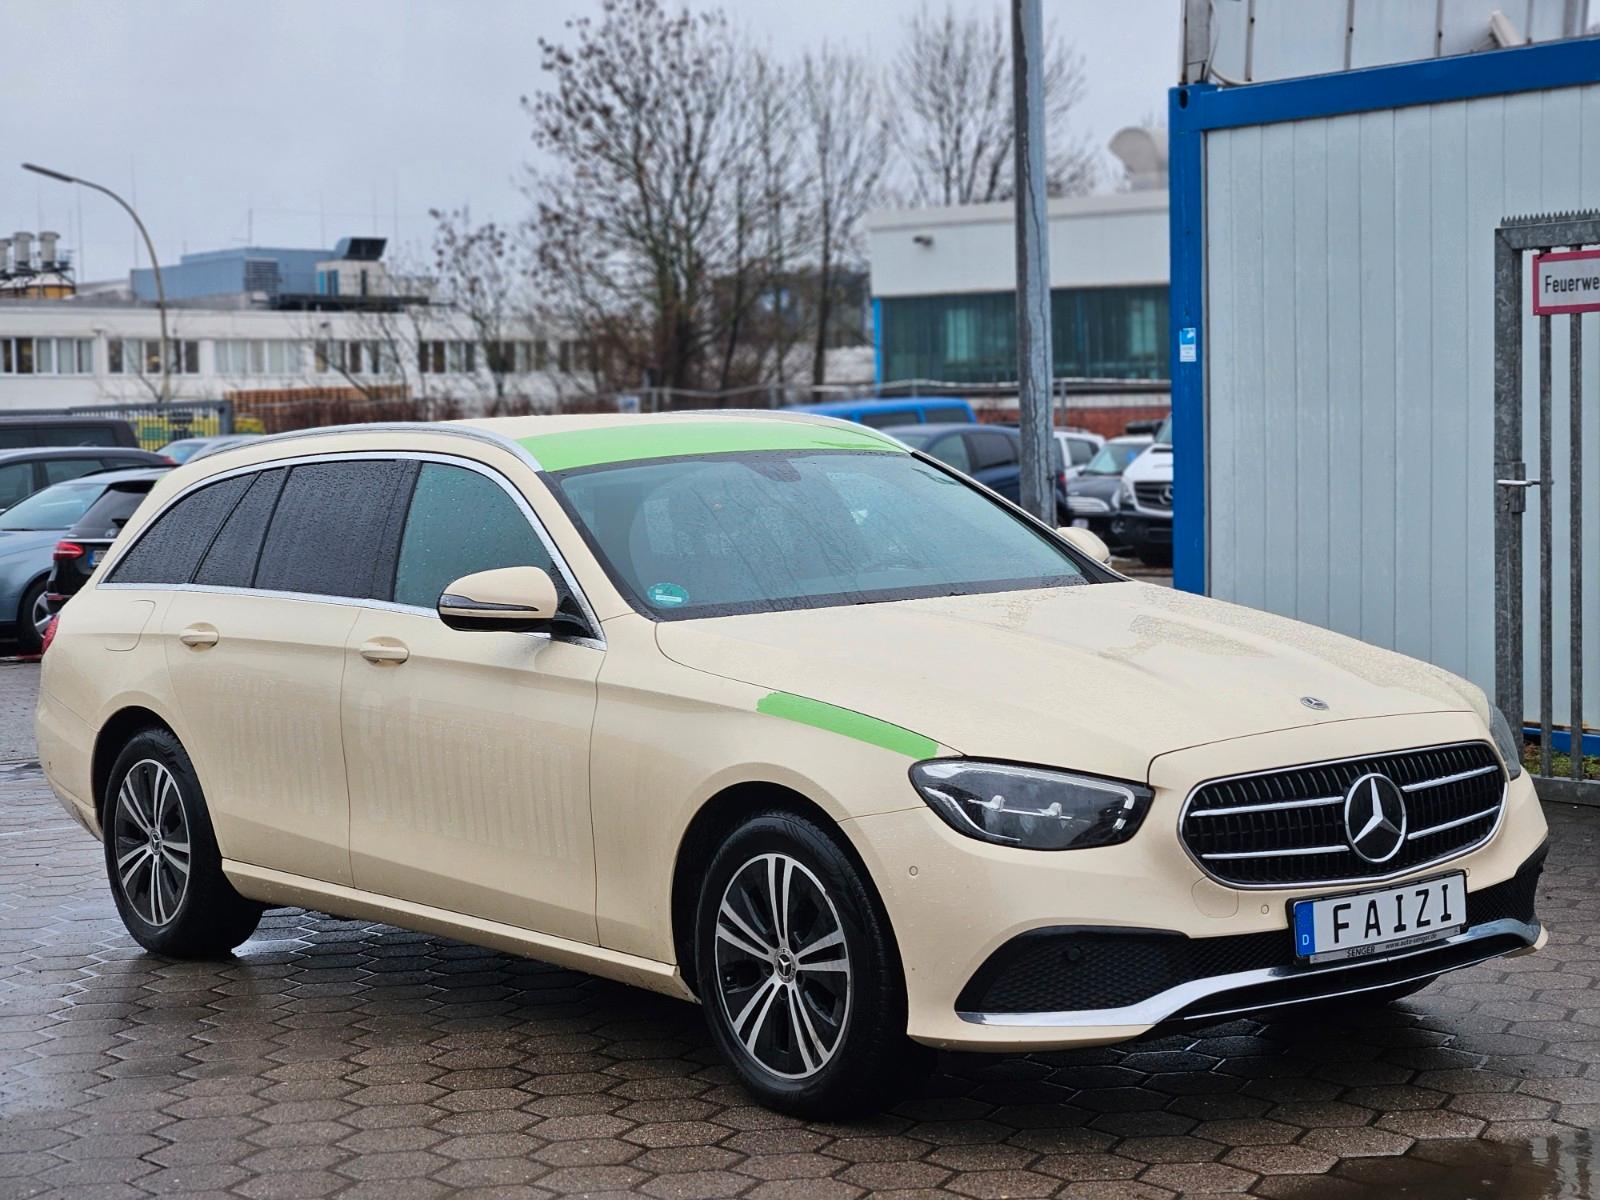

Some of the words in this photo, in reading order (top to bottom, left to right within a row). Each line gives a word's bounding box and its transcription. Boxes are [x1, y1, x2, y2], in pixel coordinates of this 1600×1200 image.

[1545, 275, 1600, 293] Feuerwe
[1333, 884, 1452, 943] FAIZI
[1302, 934, 1310, 946] D
[1346, 945, 1376, 958] SENGER
